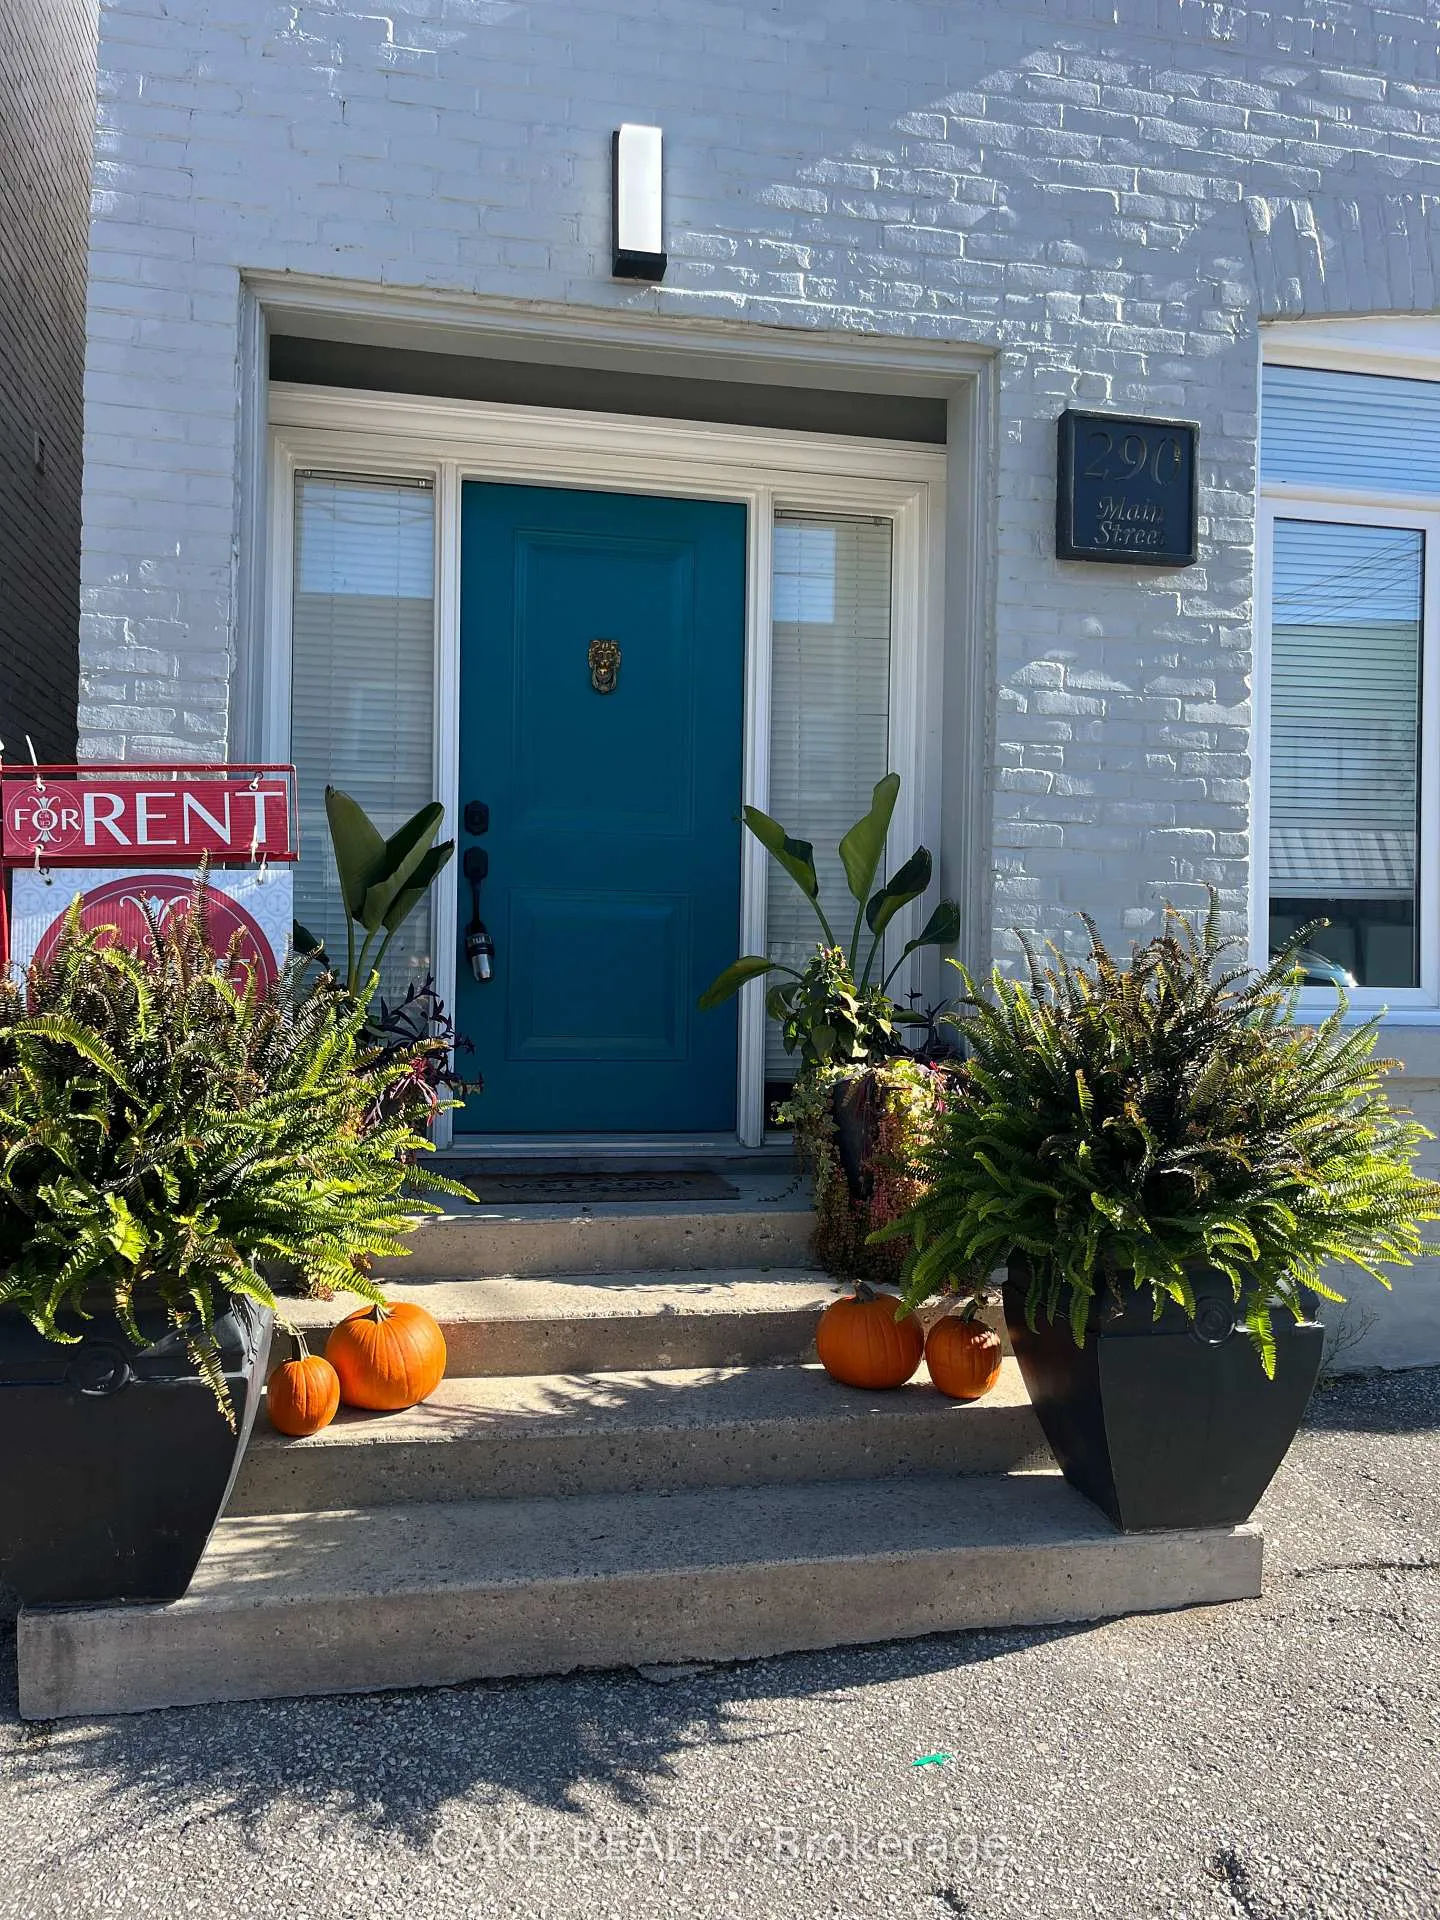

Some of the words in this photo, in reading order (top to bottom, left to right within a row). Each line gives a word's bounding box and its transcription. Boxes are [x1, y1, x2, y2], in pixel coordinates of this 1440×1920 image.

[1083, 431, 1182, 486] 290
[1096, 495, 1165, 524] Main
[1093, 520, 1166, 546] Street
[14, 808, 81, 831] FOR
[83, 791, 284, 846] RENT
